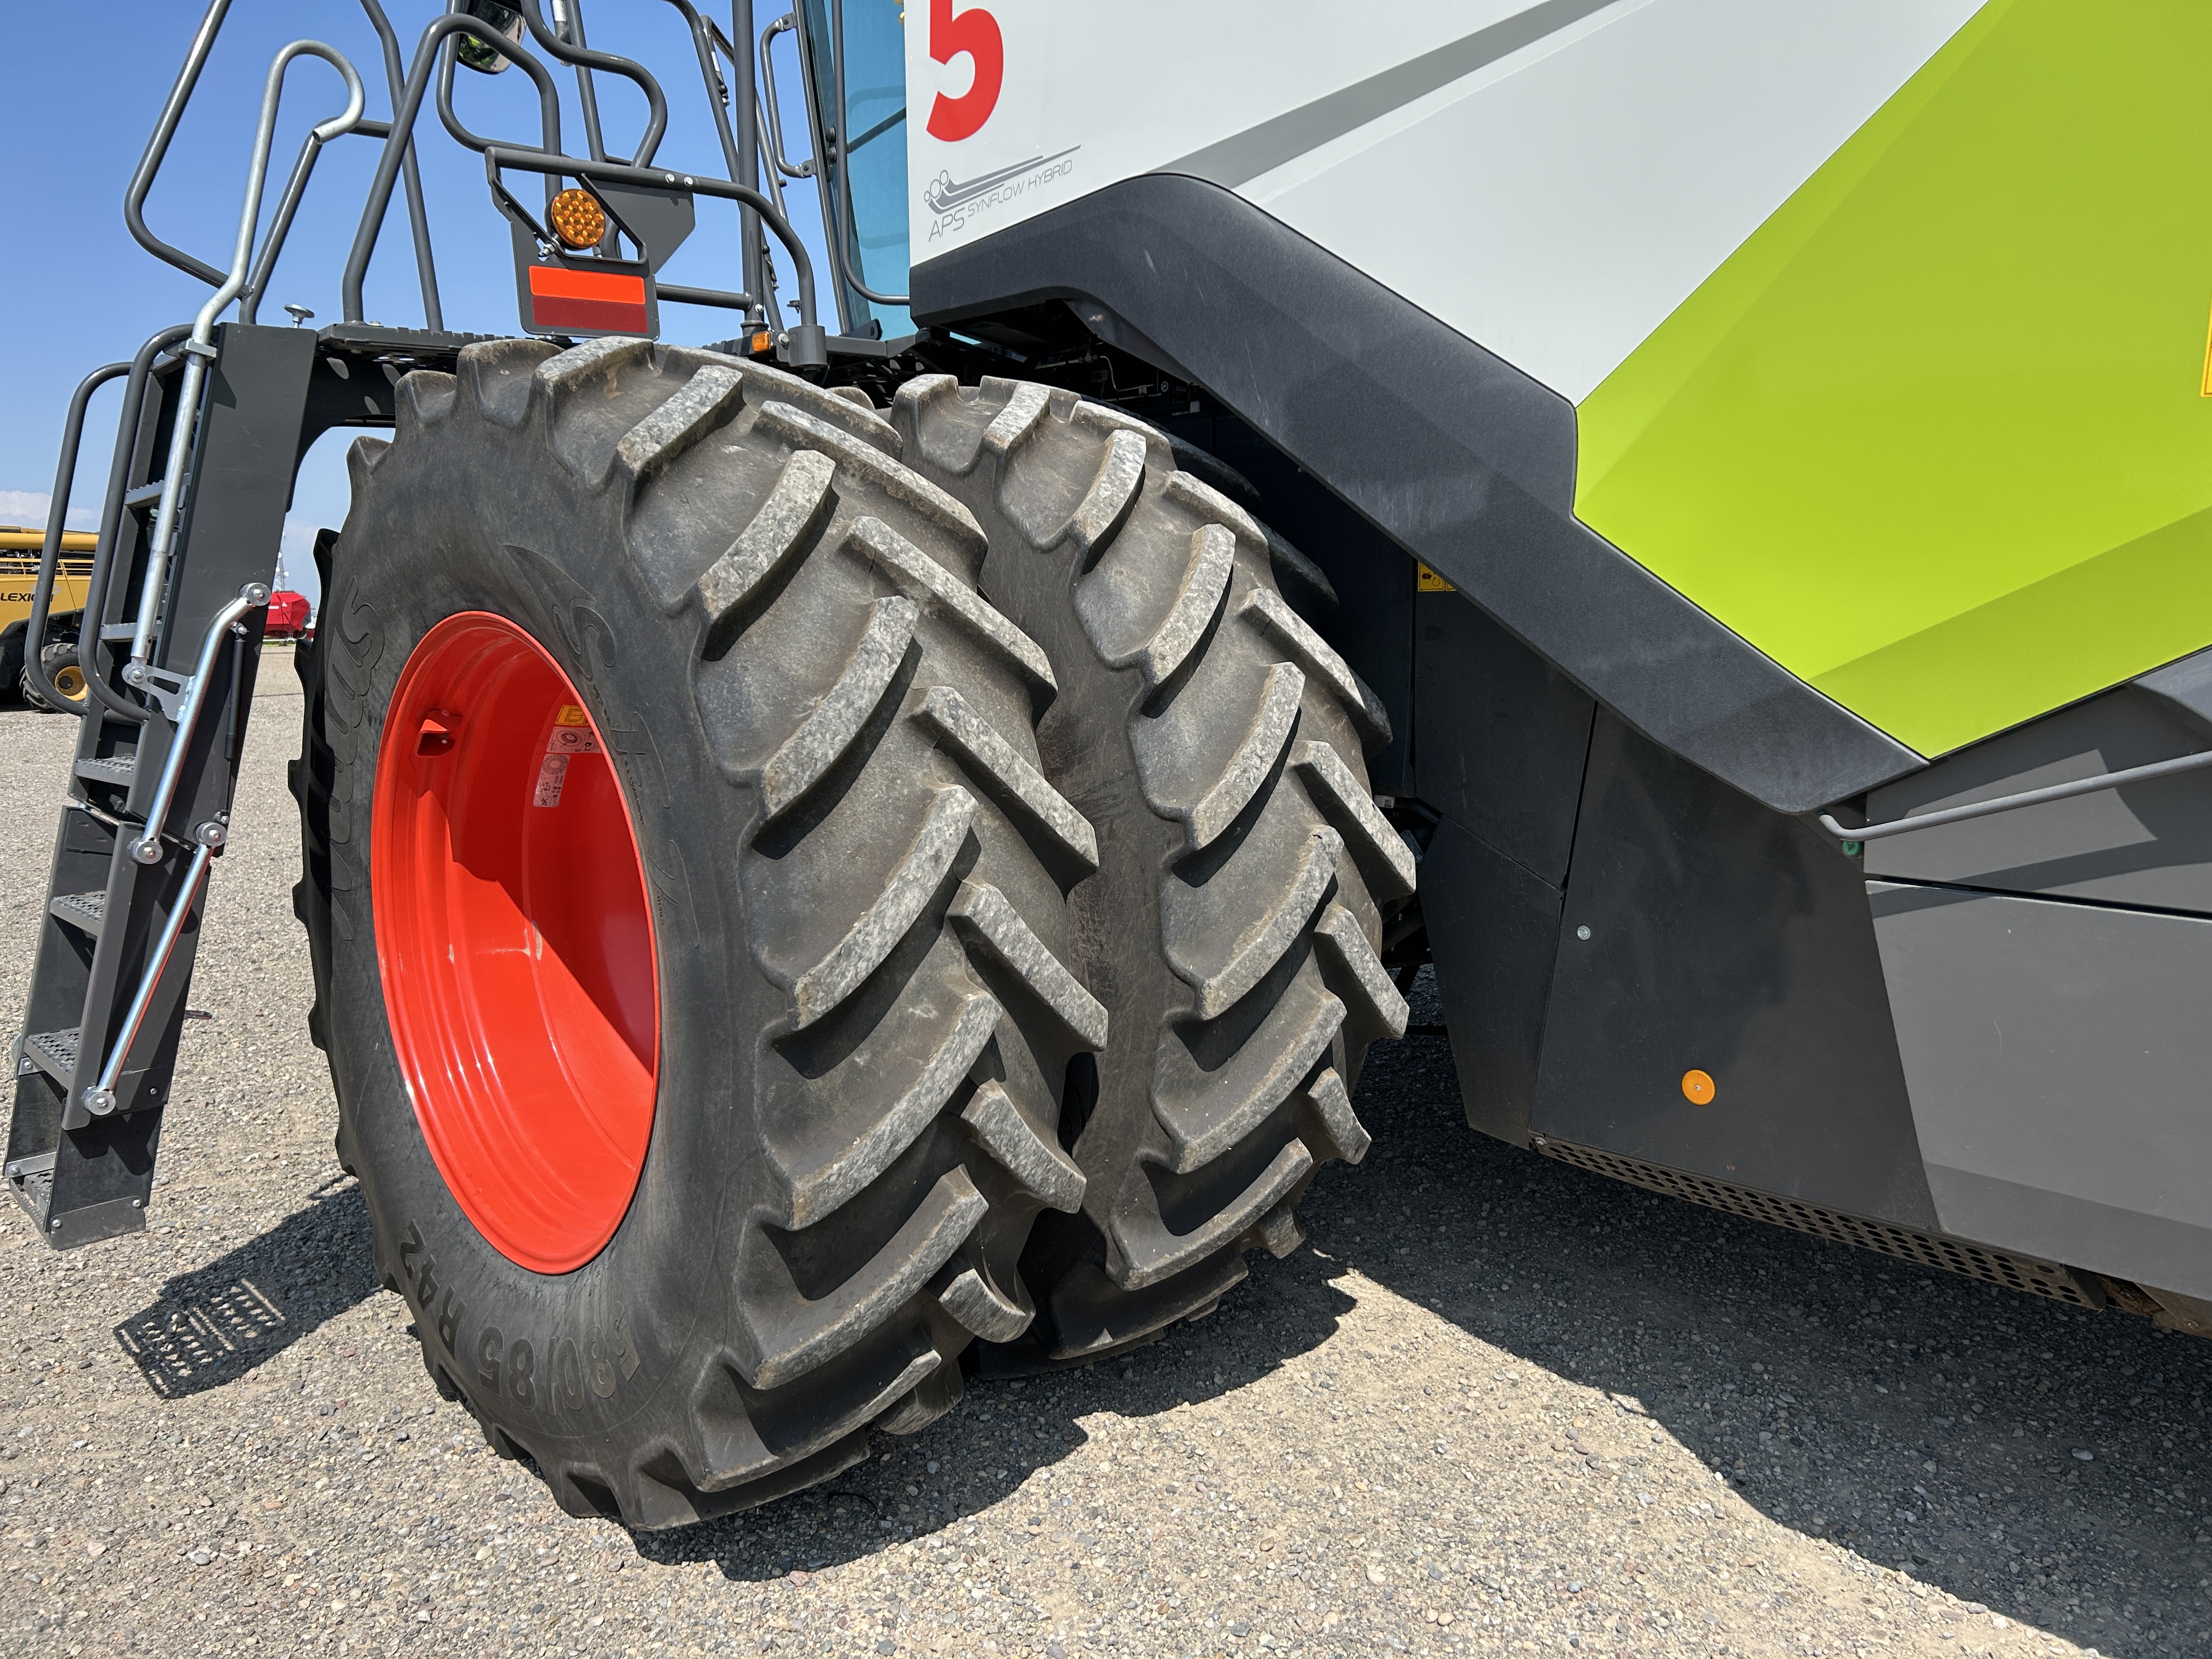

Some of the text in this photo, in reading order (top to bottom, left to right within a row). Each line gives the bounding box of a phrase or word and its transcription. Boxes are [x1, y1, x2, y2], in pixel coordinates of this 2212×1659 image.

[926, 0, 1004, 143] 5
[928, 159, 1073, 242] APS SYNFLOW HYBRID
[399, 1218, 641, 1417] 580/85 R42
